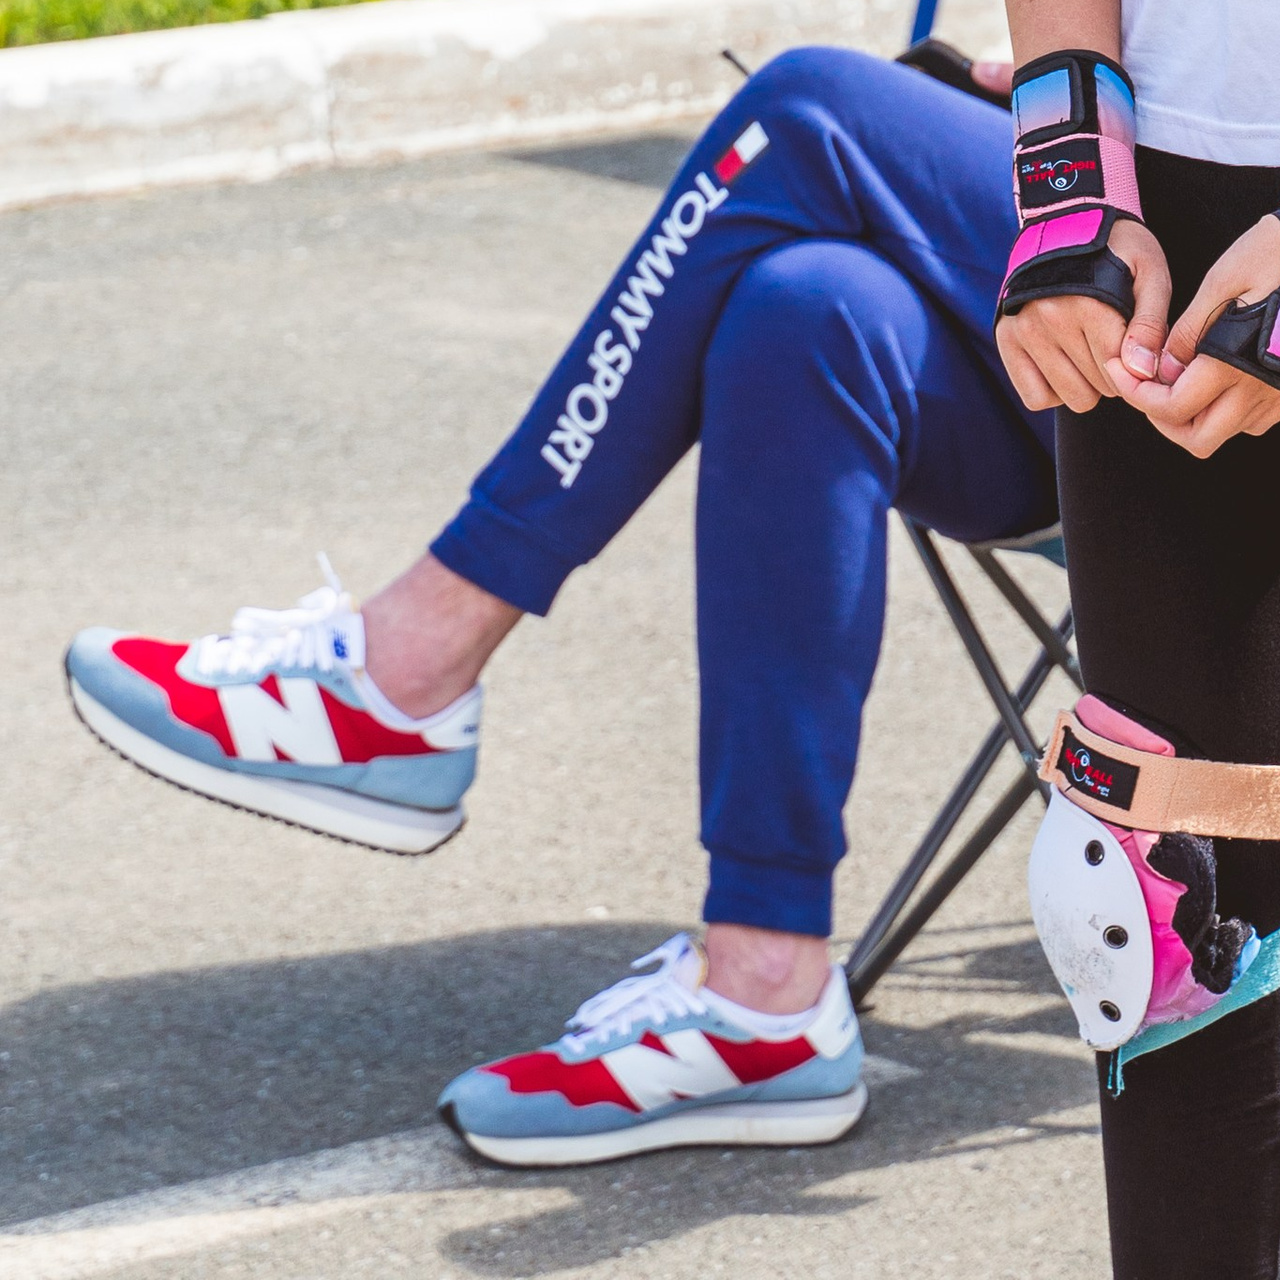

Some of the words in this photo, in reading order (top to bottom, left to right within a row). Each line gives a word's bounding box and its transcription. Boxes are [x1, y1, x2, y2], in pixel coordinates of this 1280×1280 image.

[1026, 169, 1056, 183] BALL
[1063, 160, 1096, 173] EIGHT
[610, 171, 729, 352] TOMMY
[540, 328, 634, 490] SPORT
[216, 676, 345, 768] N
